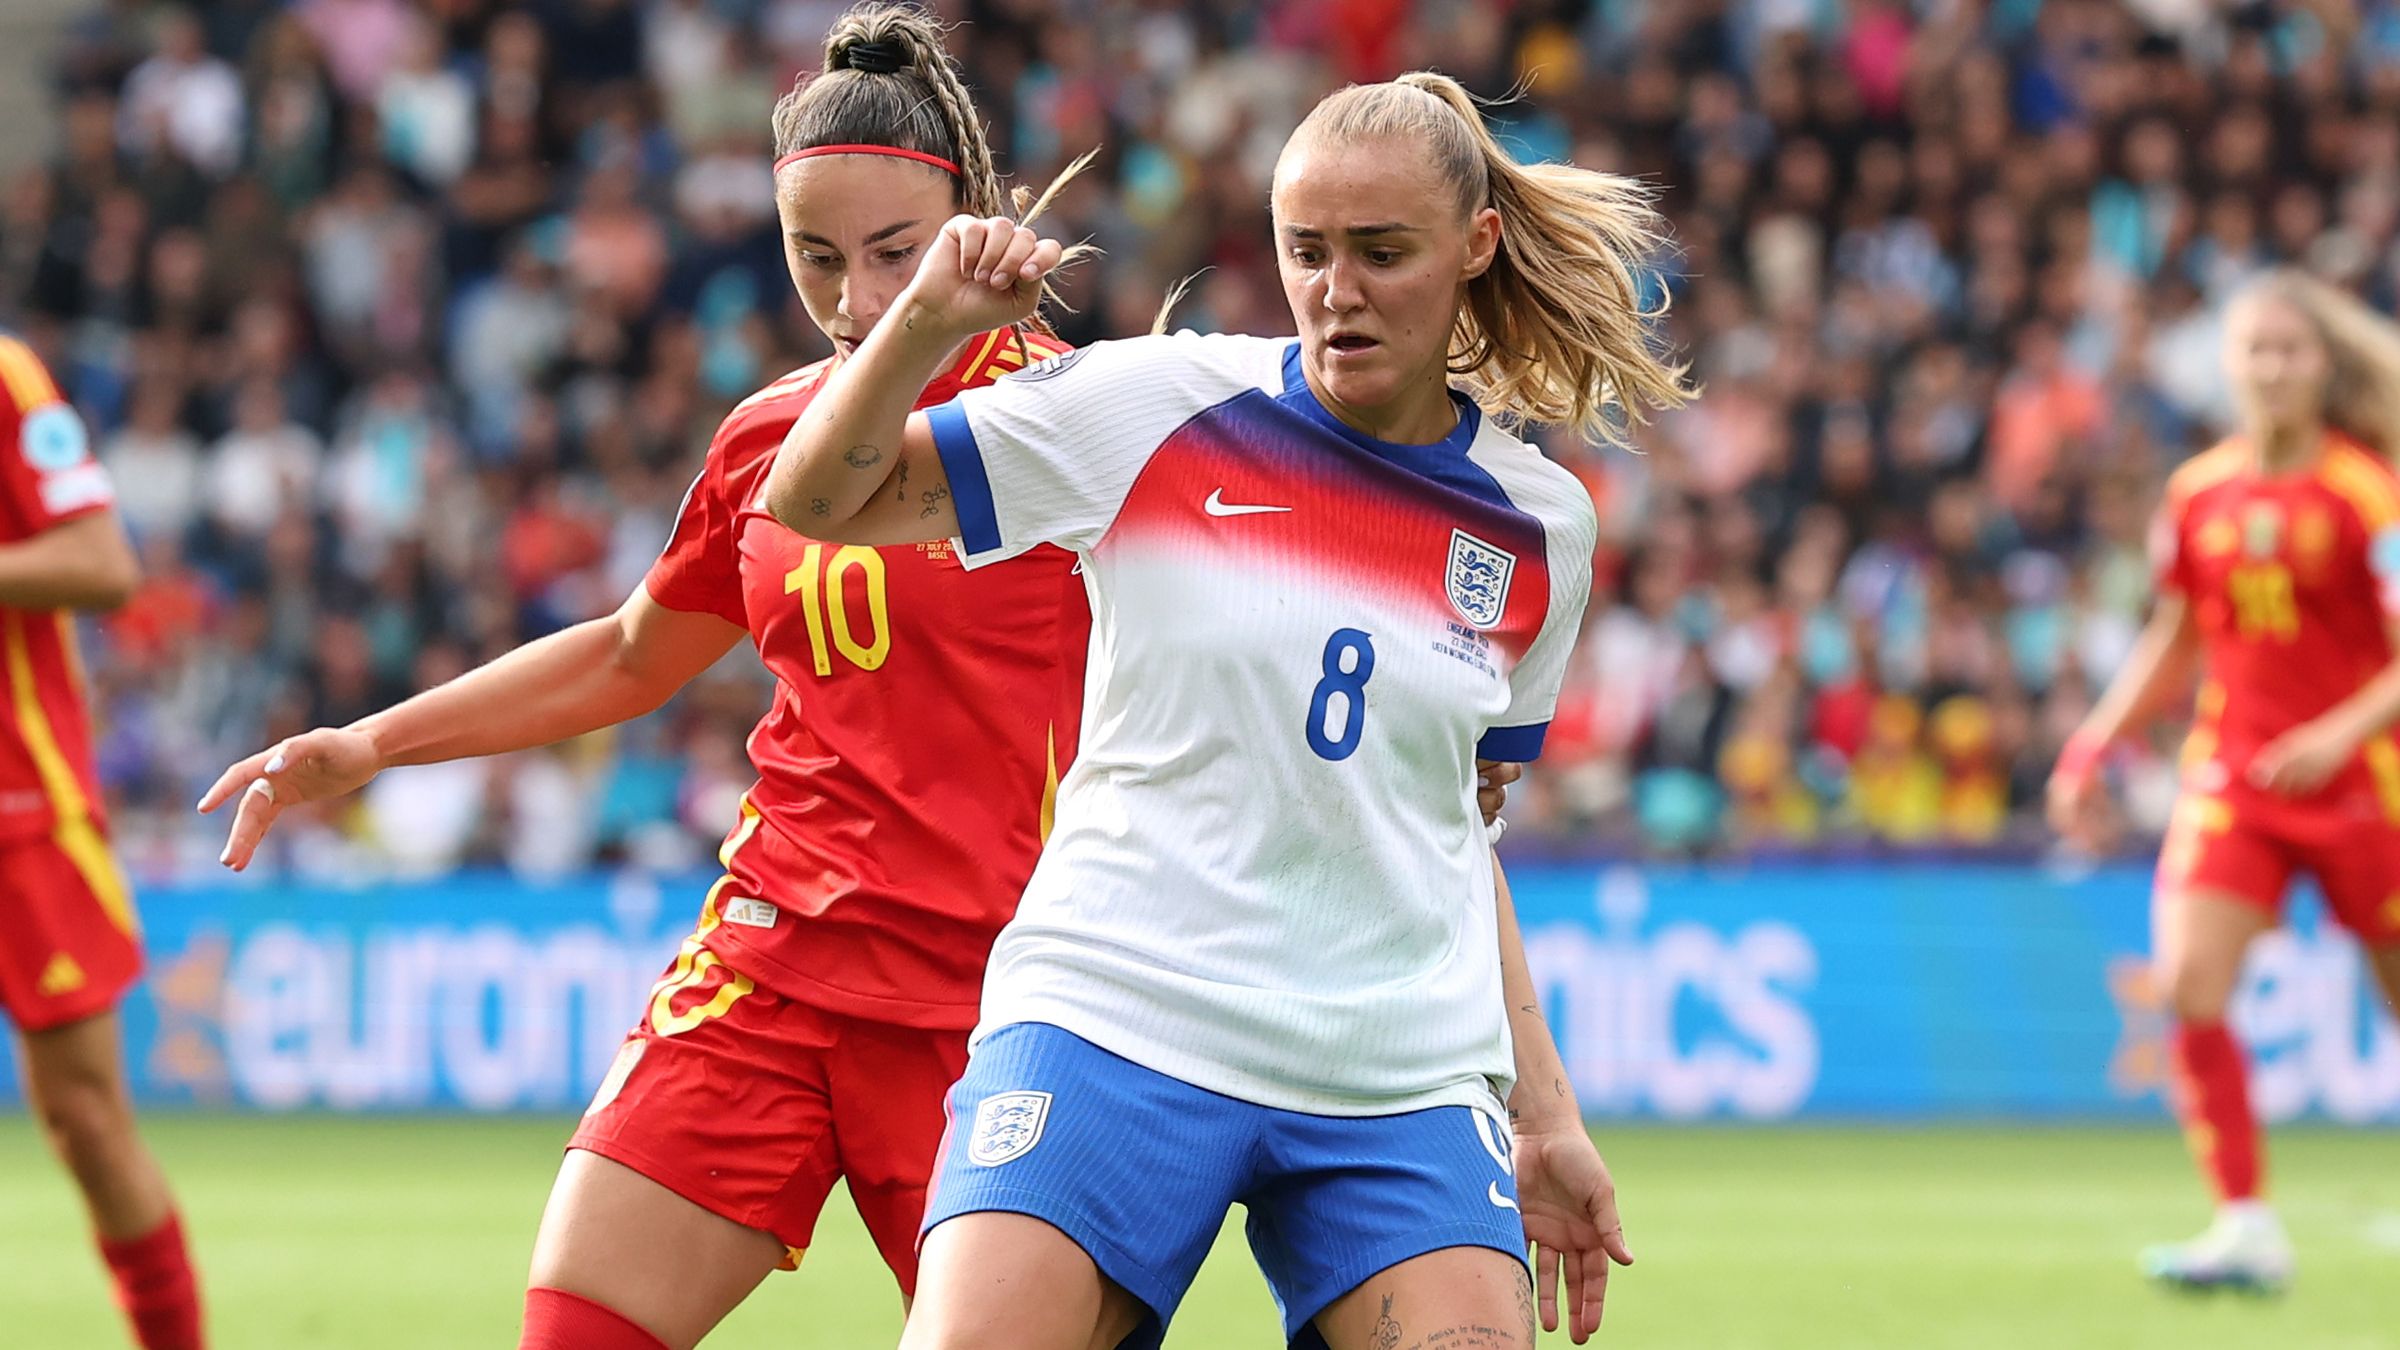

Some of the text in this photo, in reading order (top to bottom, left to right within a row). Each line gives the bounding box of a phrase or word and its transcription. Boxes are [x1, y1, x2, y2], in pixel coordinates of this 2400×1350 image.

[784, 544, 891, 676] 10
[927, 551, 949, 560] BASEL
[1305, 627, 1375, 761] 8
[1446, 621, 1477, 640] ENGLAND
[225, 872, 672, 1110] euroni
